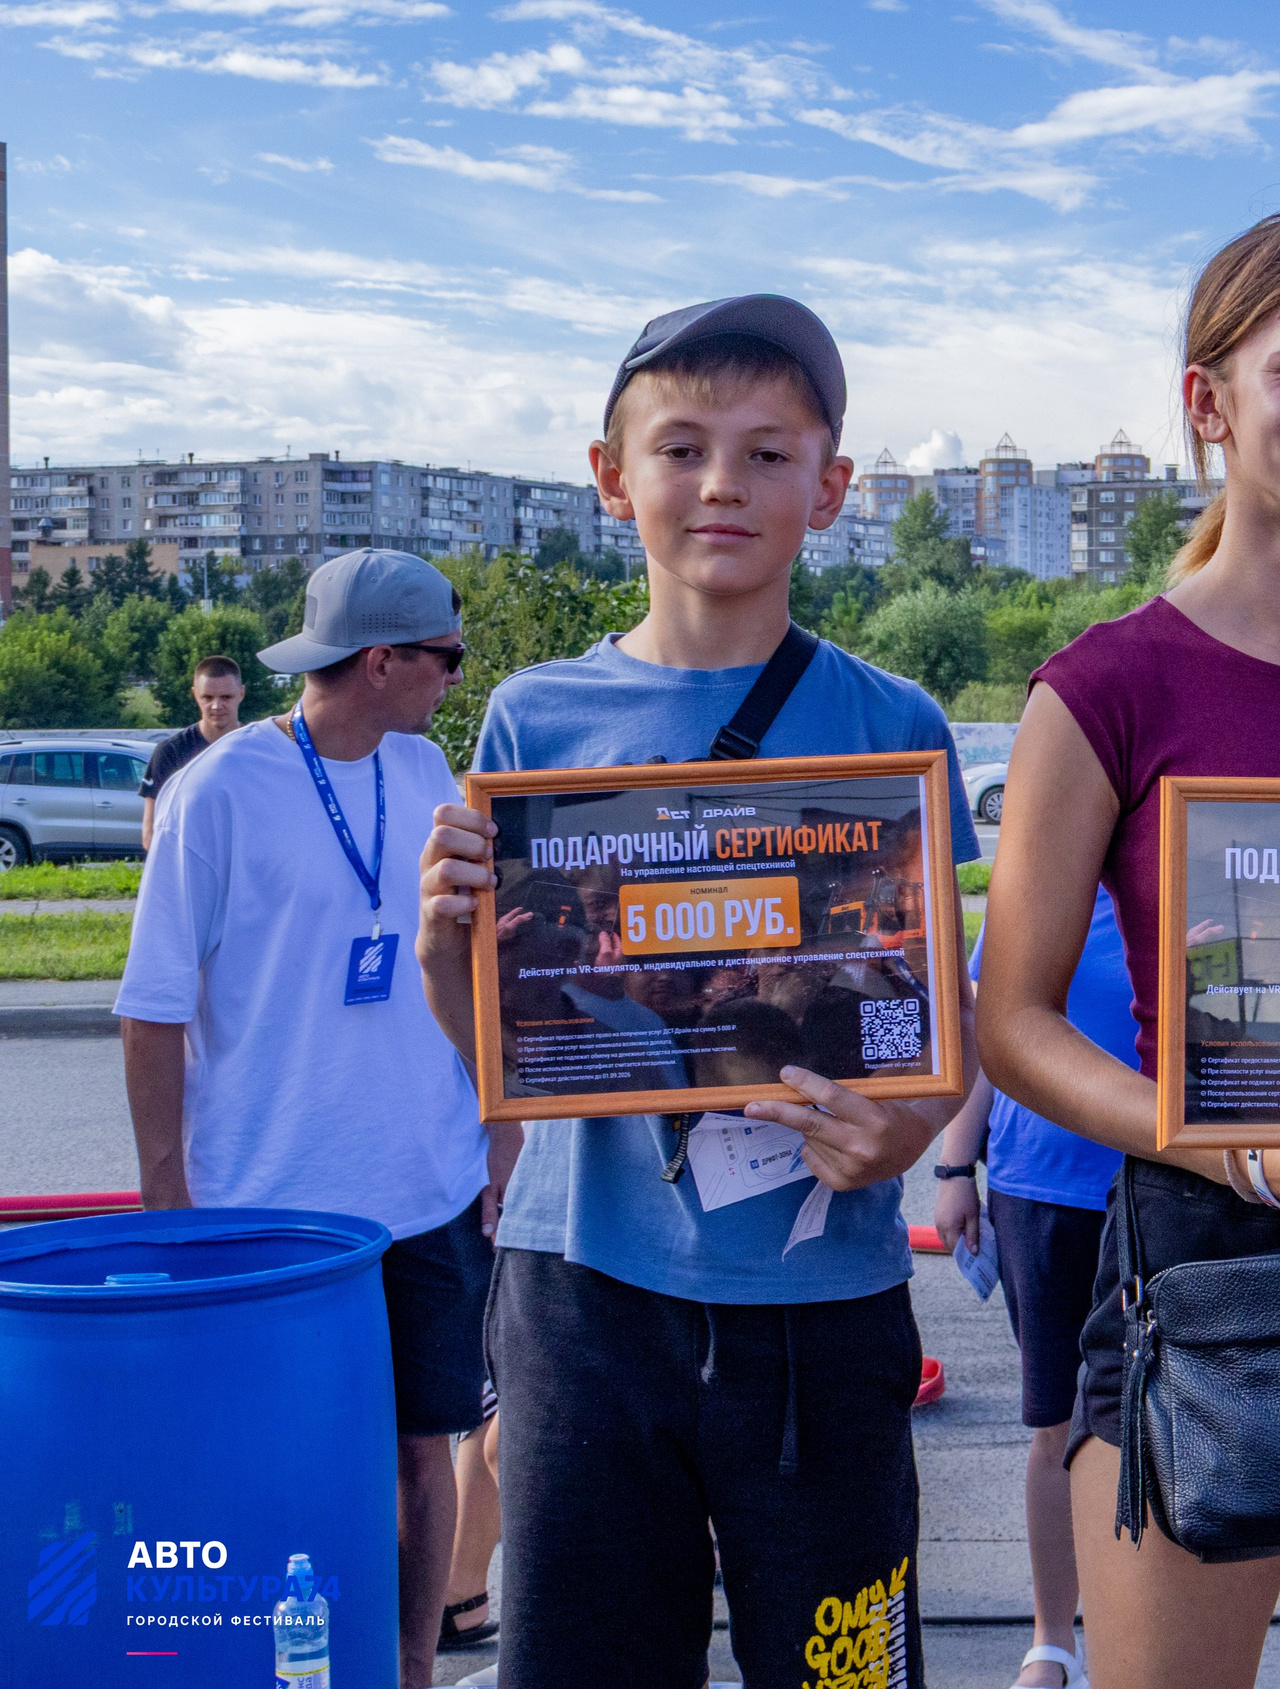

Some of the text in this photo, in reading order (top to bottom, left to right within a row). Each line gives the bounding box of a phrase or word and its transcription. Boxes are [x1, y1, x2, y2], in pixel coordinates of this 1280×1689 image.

[701, 803, 755, 818] ДРАЙВ
[531, 820, 883, 870] ПОДАРОЧНЫЙ СЕРТИФИКАТ
[620, 859, 795, 877] На управление настоящей спецтехникой
[690, 886, 728, 895] номинал
[626, 896, 794, 942] 5 000 РУБ.
[518, 966, 564, 978] Действует
[578, 961, 642, 975] VR-симулятор,
[644, 959, 716, 971] индивидуальное
[725, 955, 791, 967] дистанционное
[793, 952, 843, 963] управление
[845, 946, 904, 959] спецтехникой
[1206, 984, 1253, 995] Действует
[525, 1075, 556, 1084] Сертификат
[556, 1073, 593, 1082] действителен
[602, 1071, 630, 1079] 01.09.2026
[805, 1620, 891, 1679] GOOD
